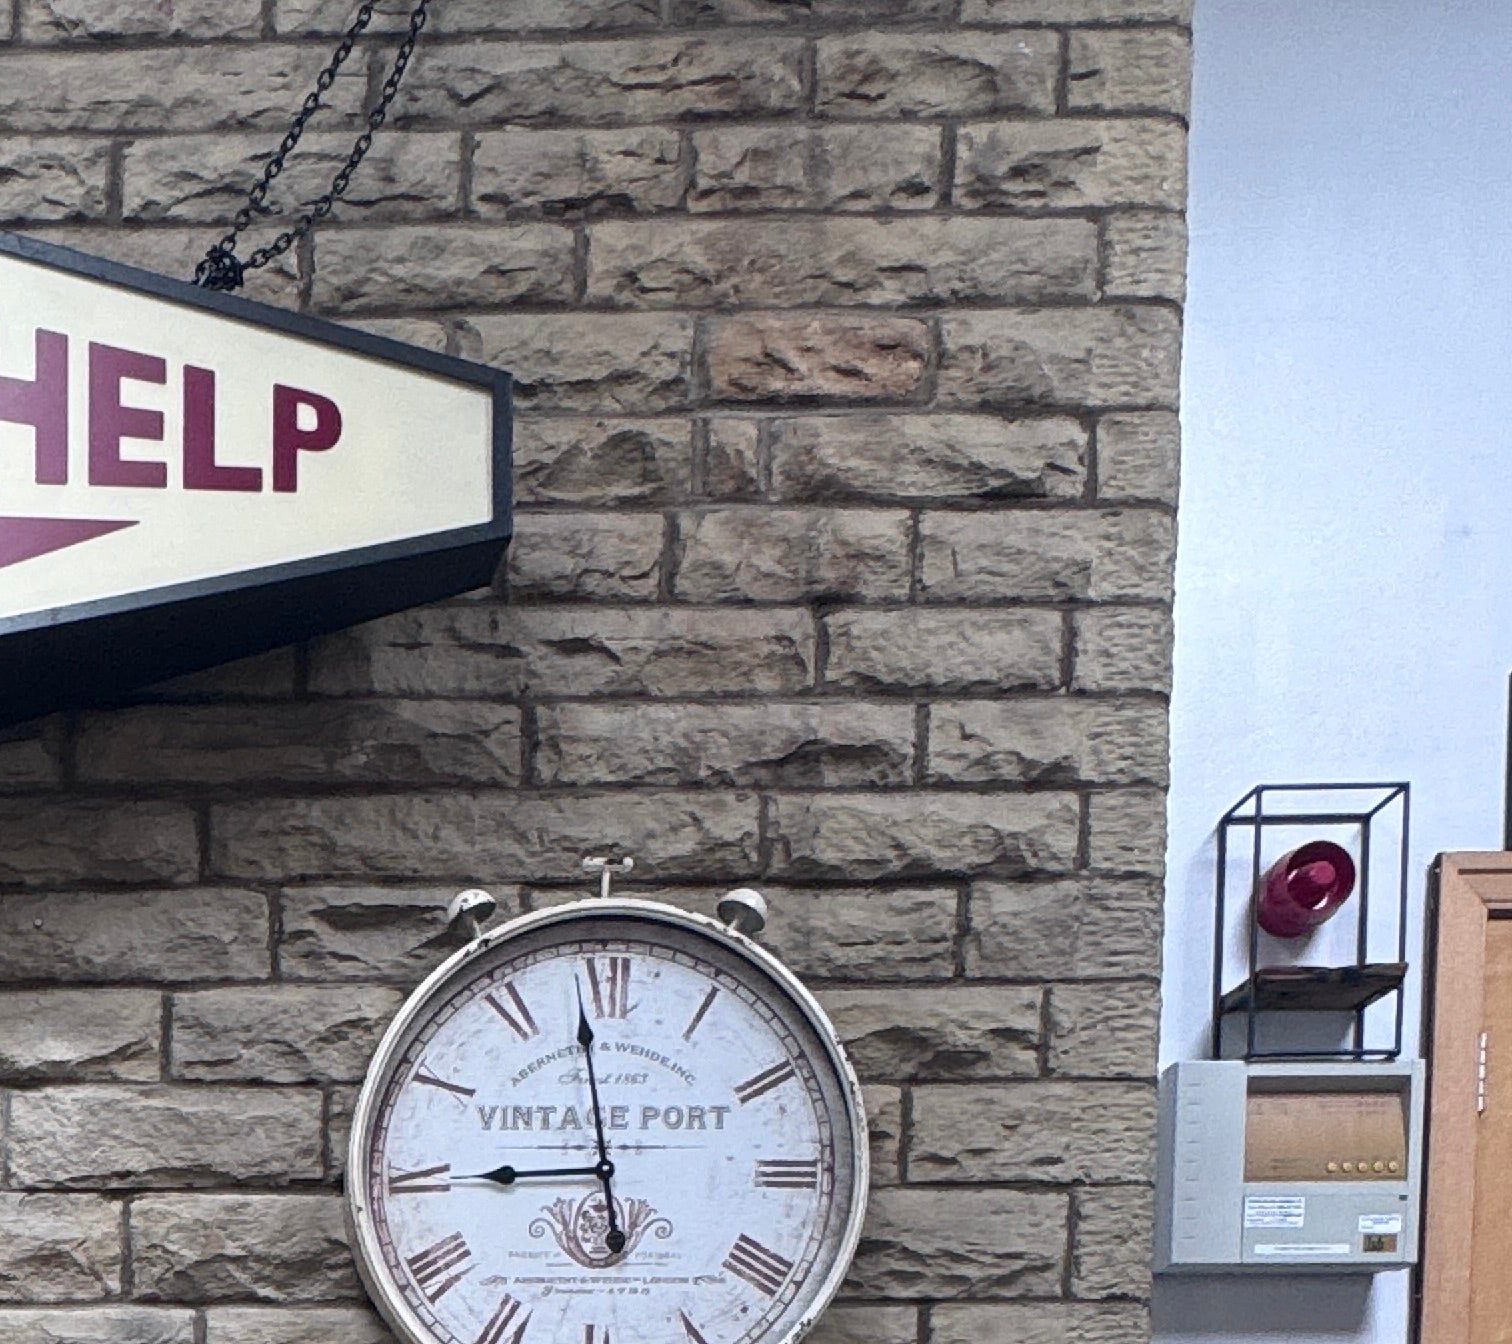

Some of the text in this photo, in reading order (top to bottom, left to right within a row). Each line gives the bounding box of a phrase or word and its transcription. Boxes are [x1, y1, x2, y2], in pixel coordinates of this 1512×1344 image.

[599, 1041, 611, 1052] &
[477, 1105, 730, 1131] VINTAGE PORT
